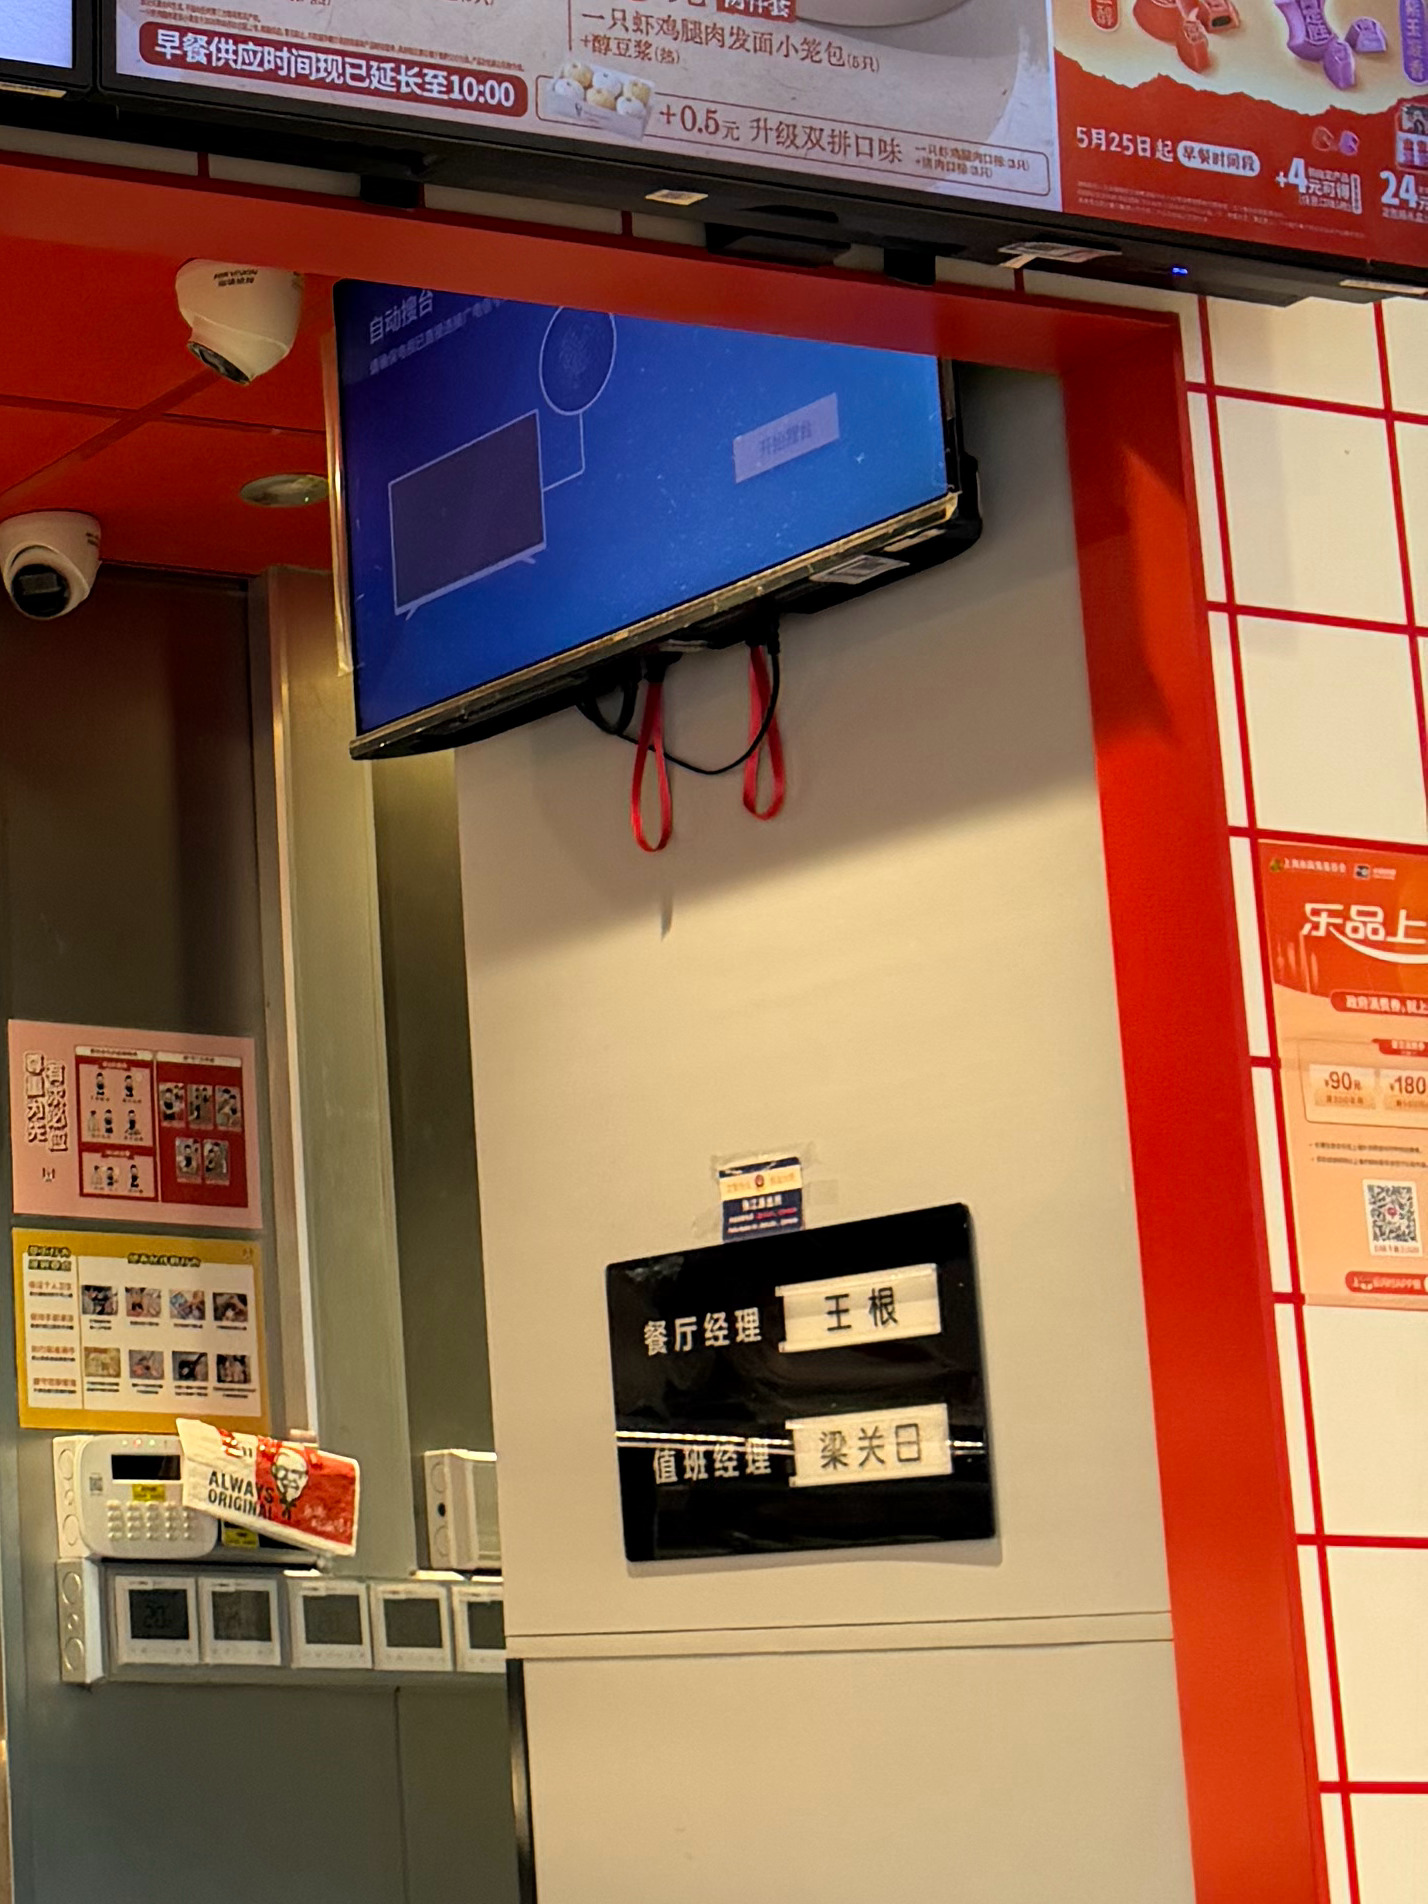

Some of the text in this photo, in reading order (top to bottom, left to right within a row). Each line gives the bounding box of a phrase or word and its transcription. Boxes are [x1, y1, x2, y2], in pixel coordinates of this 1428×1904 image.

[154, 29, 515, 108] 早餐供应时间现已延长至10:00
[660, 105, 903, 164] +0.5元 升级双拼口味
[1076, 126, 1255, 172] 5月25日起 早餐时间段
[1380, 171, 1417, 207] 24
[1302, 903, 1428, 944] 乐品上
[644, 1287, 898, 1356] 餐厅经理 王根
[653, 1422, 923, 1485] 值班经理 梁关日
[209, 1471, 274, 1504] ALWAYS
[209, 1489, 272, 1521] ORIGINAL
